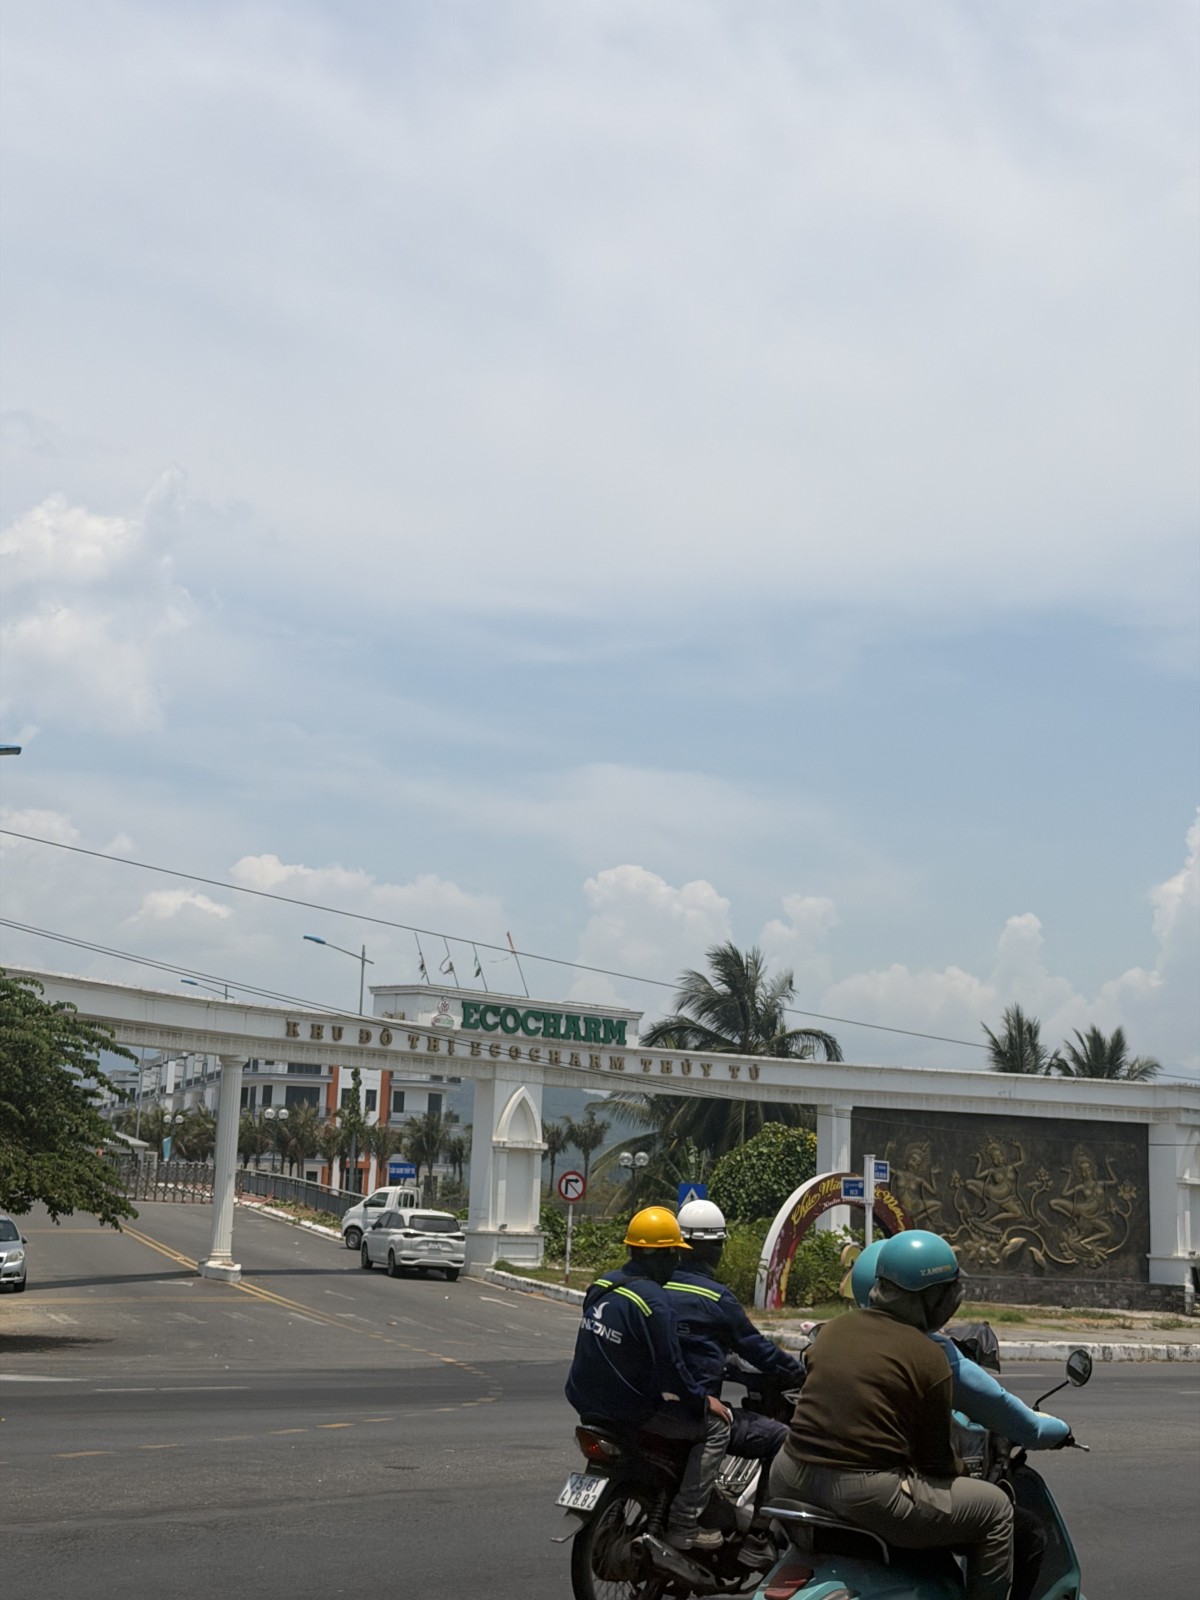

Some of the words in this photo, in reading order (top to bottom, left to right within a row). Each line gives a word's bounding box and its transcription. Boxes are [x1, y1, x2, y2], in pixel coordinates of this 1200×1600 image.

[286, 1020, 344, 1041] KHU
[359, 1027, 393, 1046] ĐÔ
[407, 1033, 456, 1056] THỊ
[470, 1041, 625, 1071] ECOCHARM
[461, 1000, 627, 1047] ECOCHARM
